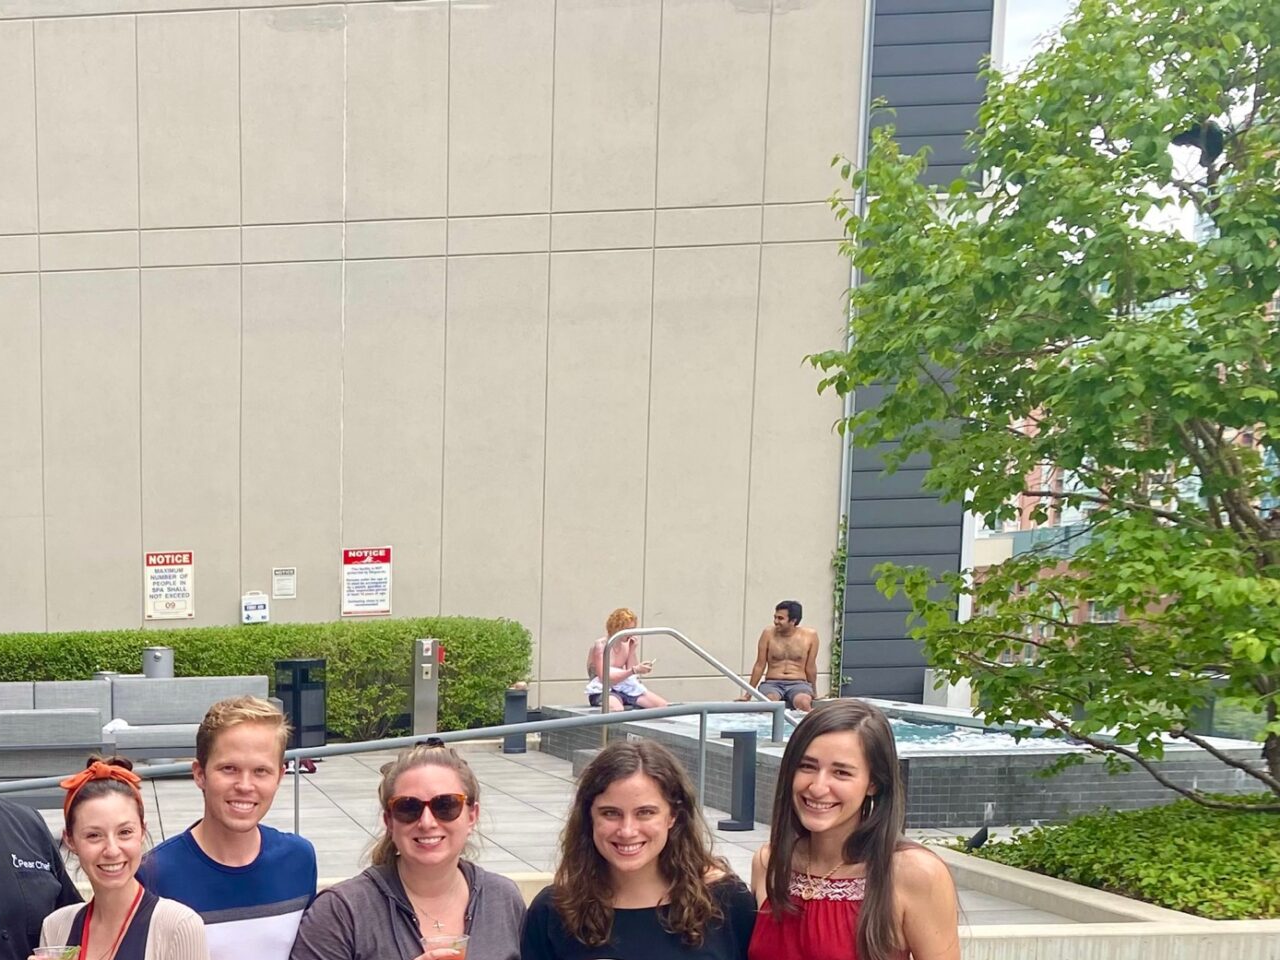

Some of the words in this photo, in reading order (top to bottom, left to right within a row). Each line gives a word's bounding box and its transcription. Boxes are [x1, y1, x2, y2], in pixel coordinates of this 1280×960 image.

[148, 554, 190, 565] NOTICE
[18, 859, 35, 869] Pear
[35, 860, 50, 871] Chef
